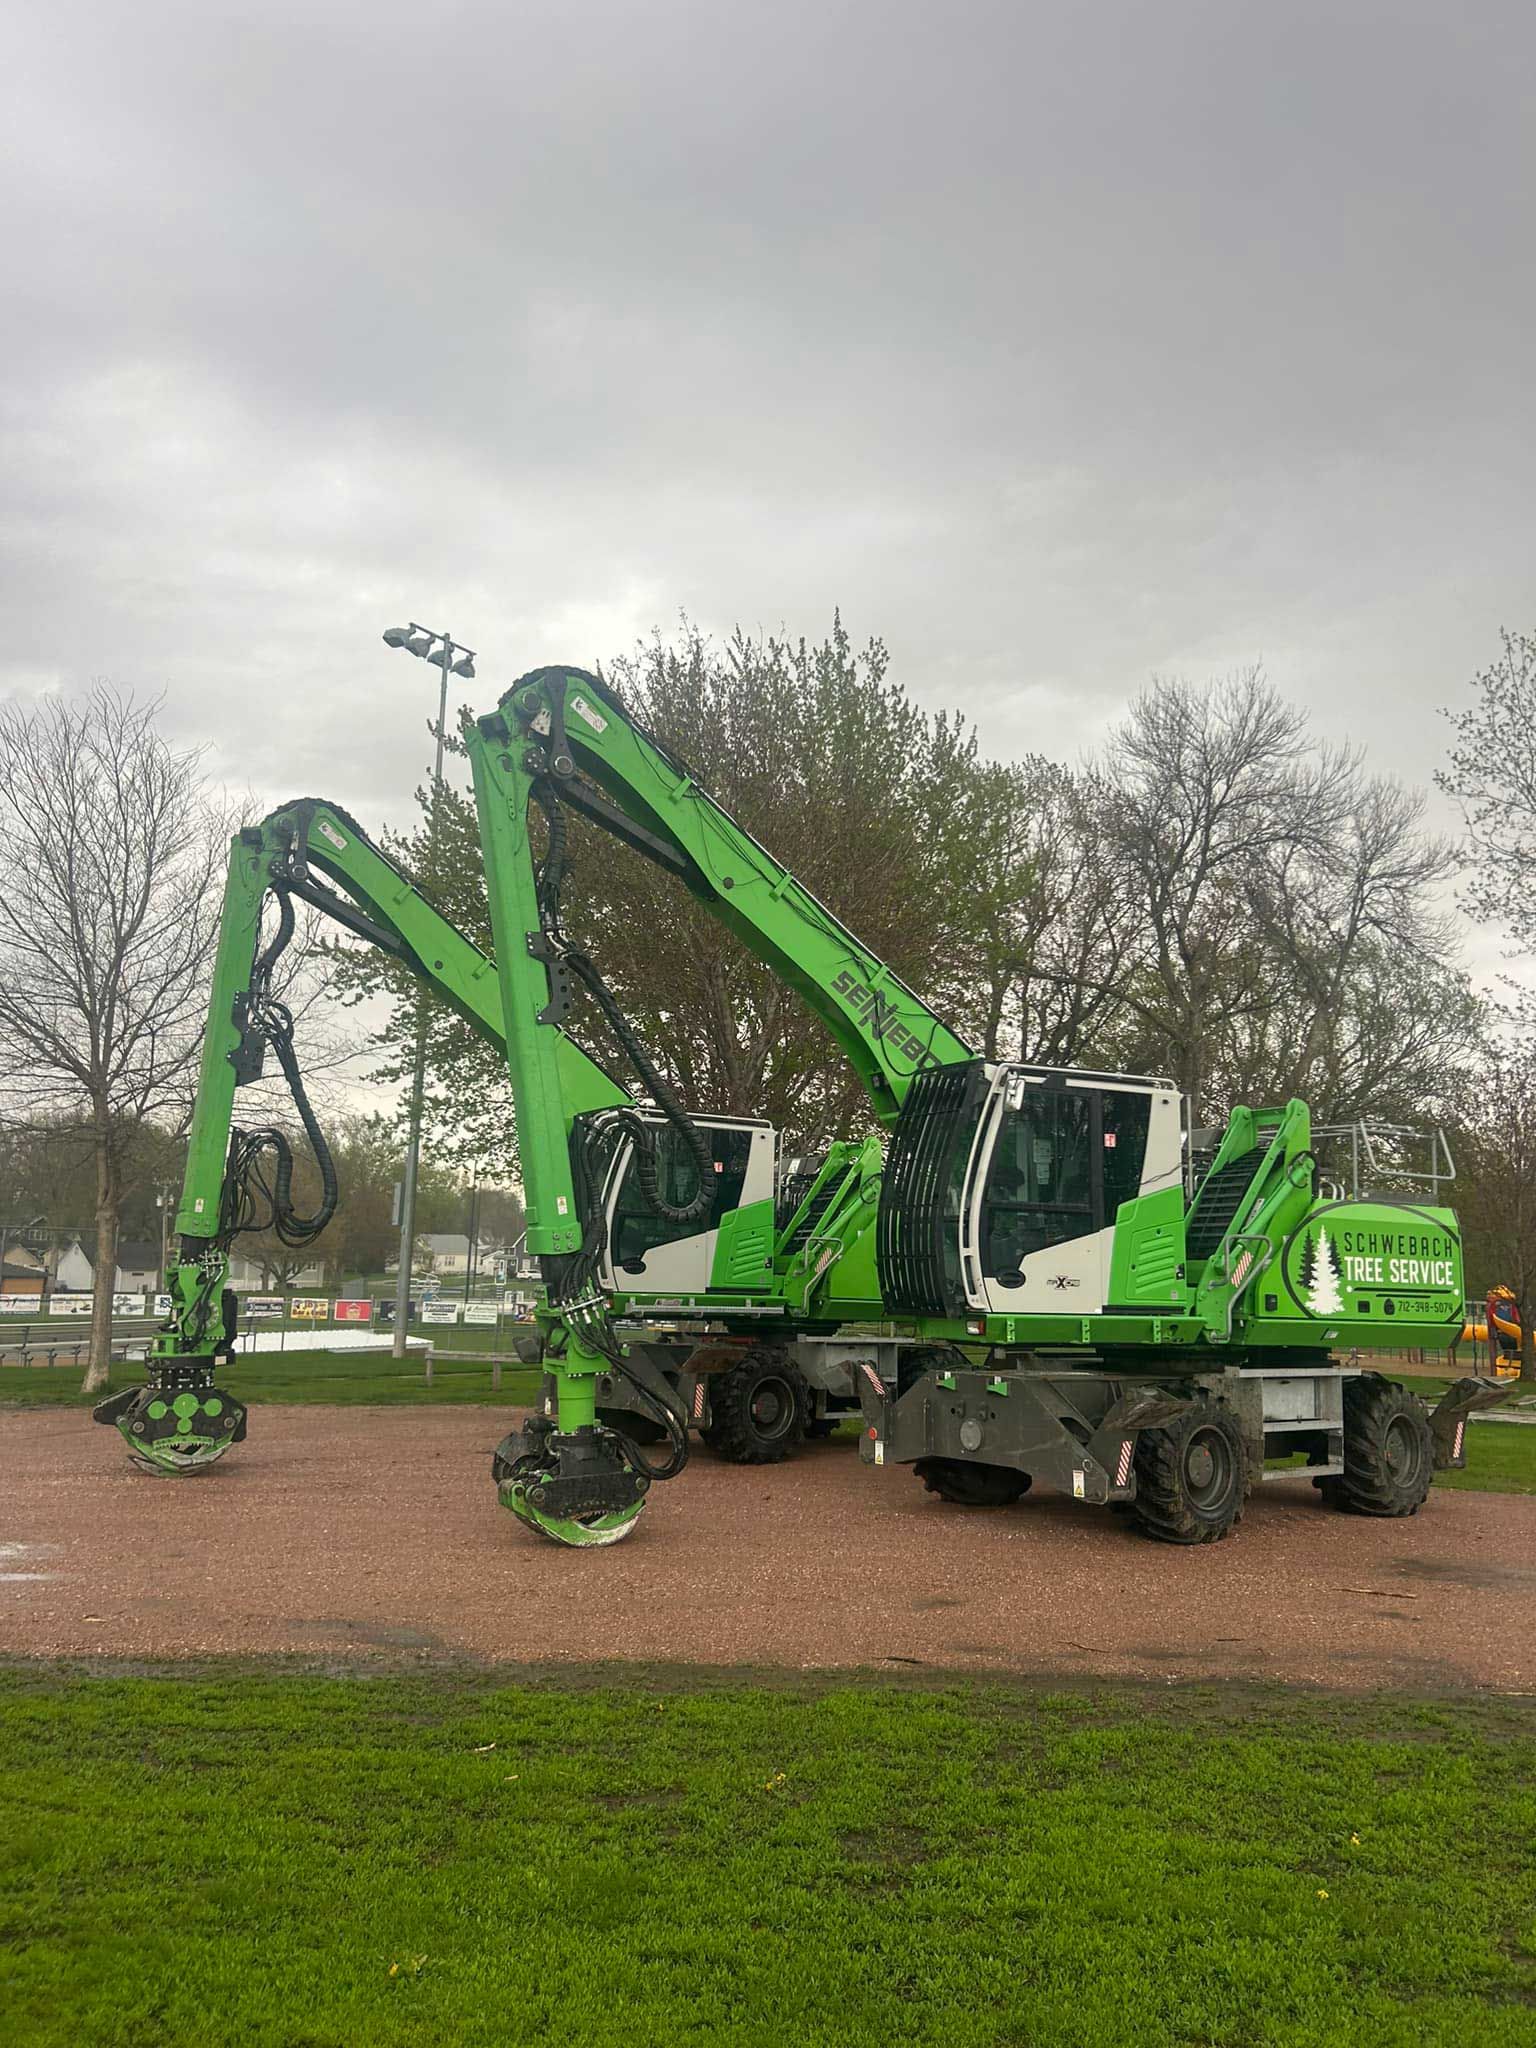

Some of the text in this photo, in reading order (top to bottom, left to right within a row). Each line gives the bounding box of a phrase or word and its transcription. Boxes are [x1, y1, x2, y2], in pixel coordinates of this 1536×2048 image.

[1344, 1232, 1452, 1257] SCHWEBACH
[1344, 1256, 1454, 1285] TREE SERVICE
[1398, 1301, 1453, 1313] 712-348-5074
